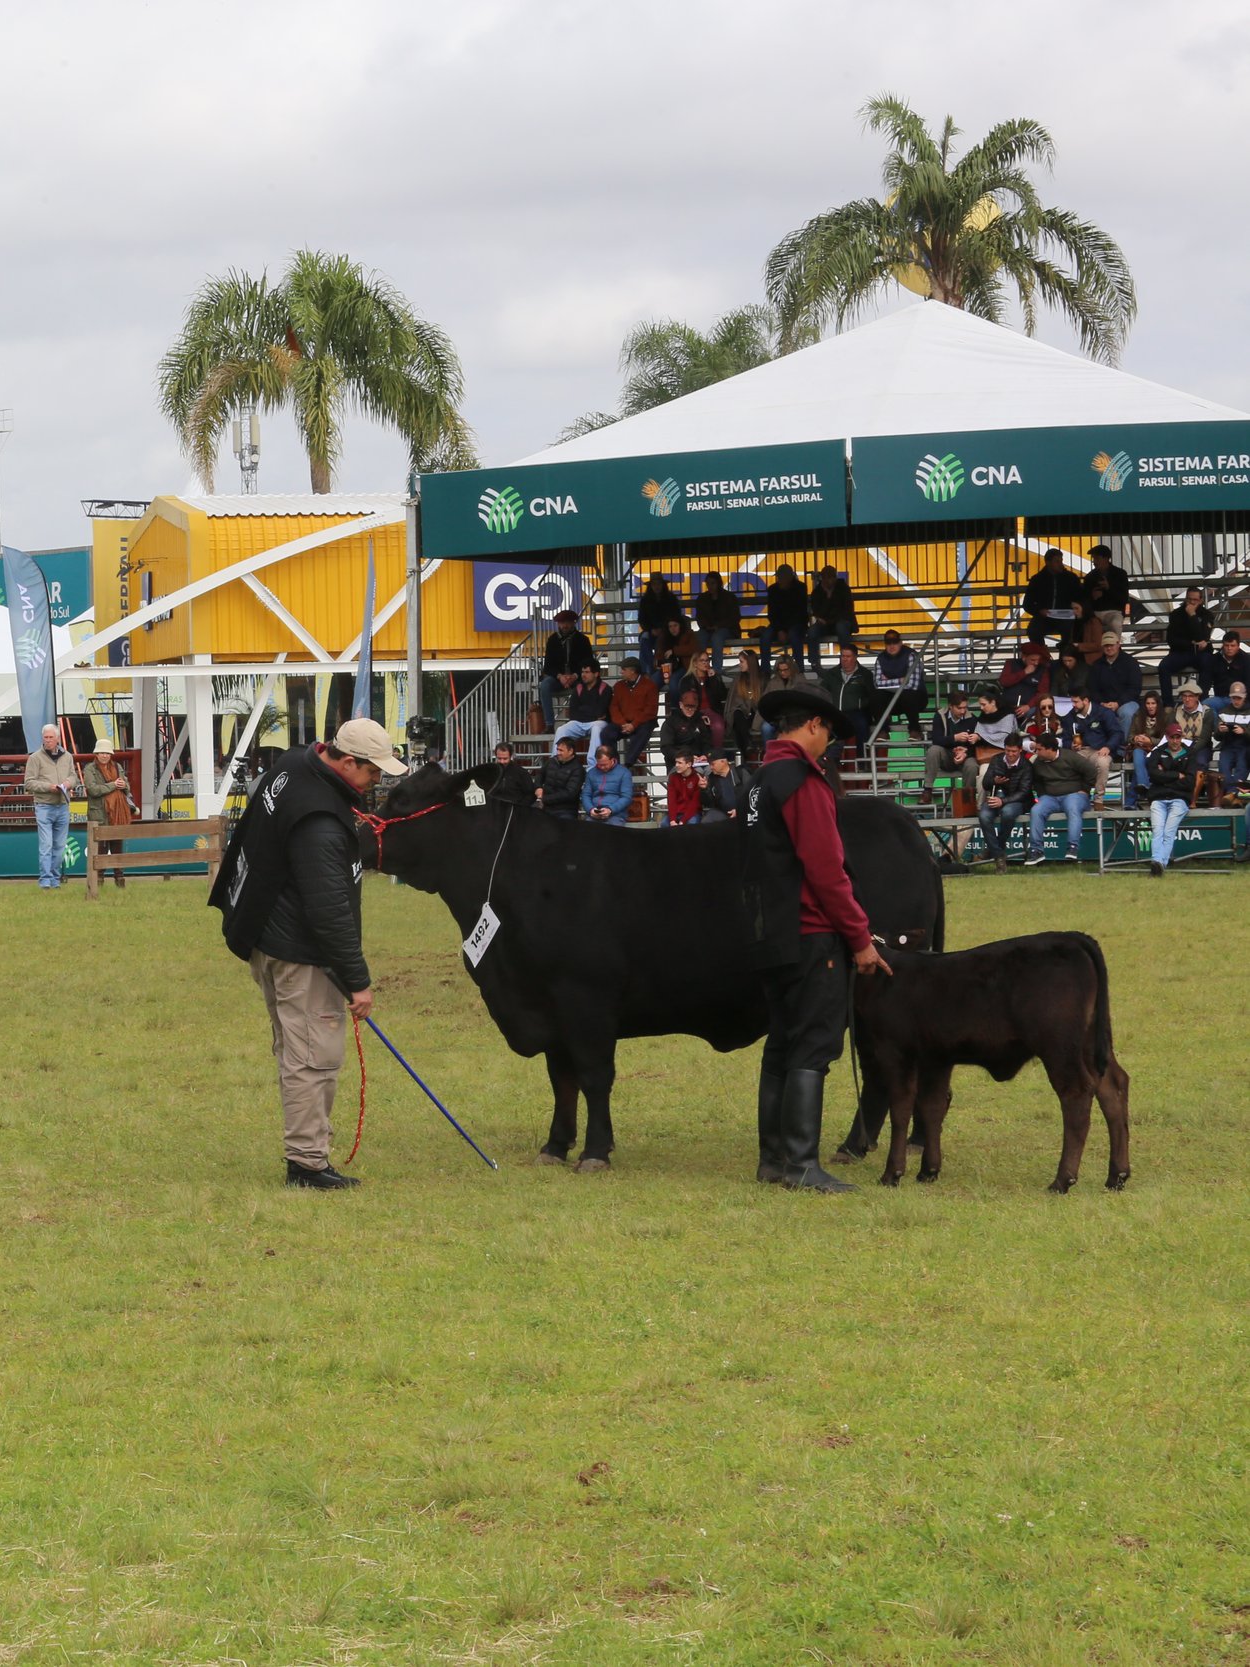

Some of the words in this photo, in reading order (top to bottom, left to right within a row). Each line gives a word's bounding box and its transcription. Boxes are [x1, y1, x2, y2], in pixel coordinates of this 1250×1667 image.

[1138, 456, 1213, 472] SISTEMA
[1218, 454, 1250, 469] FAR
[971, 465, 1022, 486] CNA
[1139, 477, 1176, 487] FARSUL
[1182, 476, 1217, 485] SENAR
[1222, 474, 1249, 484] CASA
[685, 478, 756, 498] SISTEMA
[760, 474, 822, 492] FARSUL
[530, 496, 578, 517] CNA
[686, 500, 723, 512] FARSUL
[726, 498, 760, 508] SENAR
[764, 496, 790, 506] CASA
[791, 493, 823, 503] RURAL
[58, 606, 70, 619] Sul
[466, 794, 484, 806] 11J
[1174, 829, 1202, 840] NA
[471, 918, 490, 948] 1492
